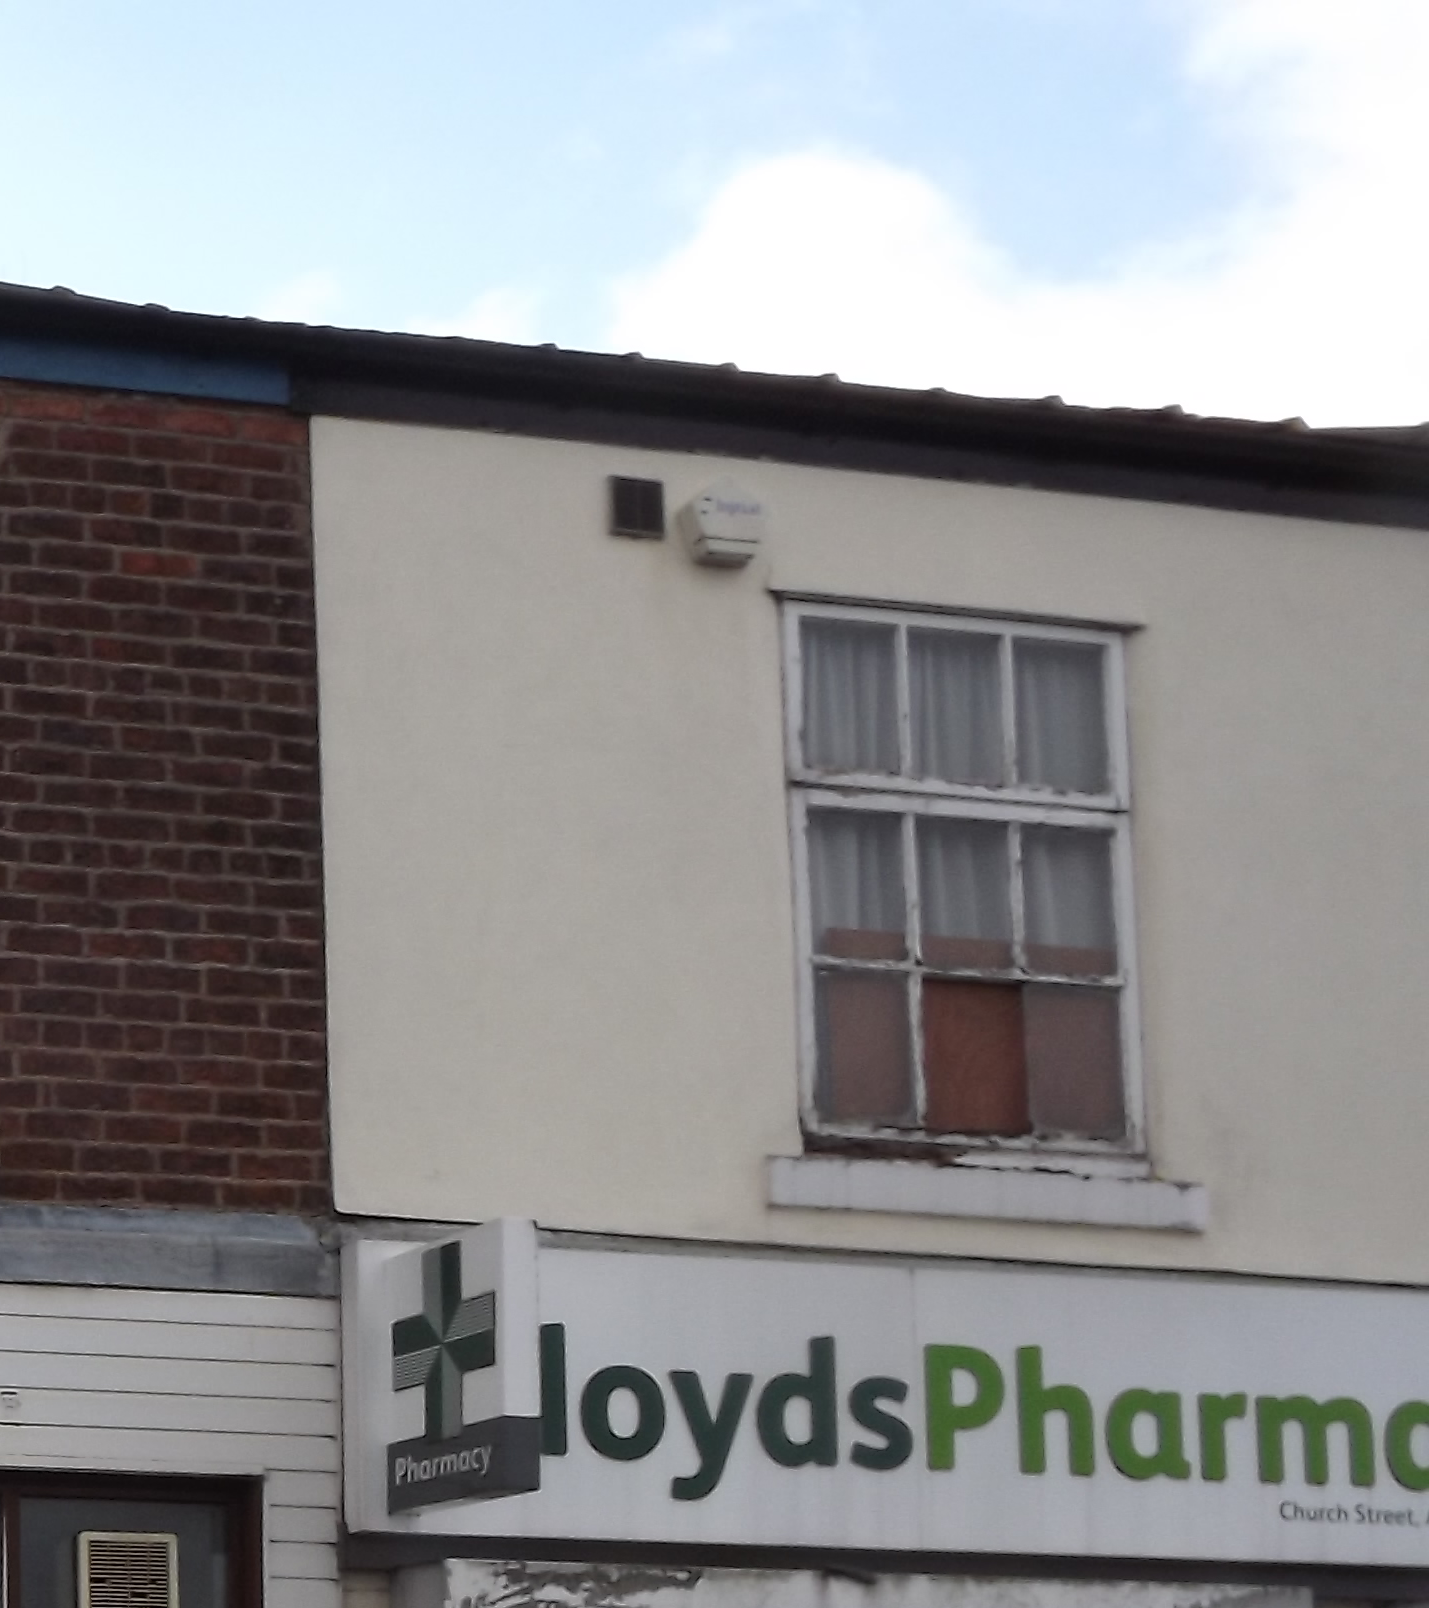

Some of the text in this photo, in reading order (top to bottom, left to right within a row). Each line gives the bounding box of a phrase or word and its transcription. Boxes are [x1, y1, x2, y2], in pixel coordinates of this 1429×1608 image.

[540, 1321, 1429, 1502] loydsPharma
[394, 1445, 492, 1486] Pharmacy
[1279, 1499, 1348, 1522] Church
